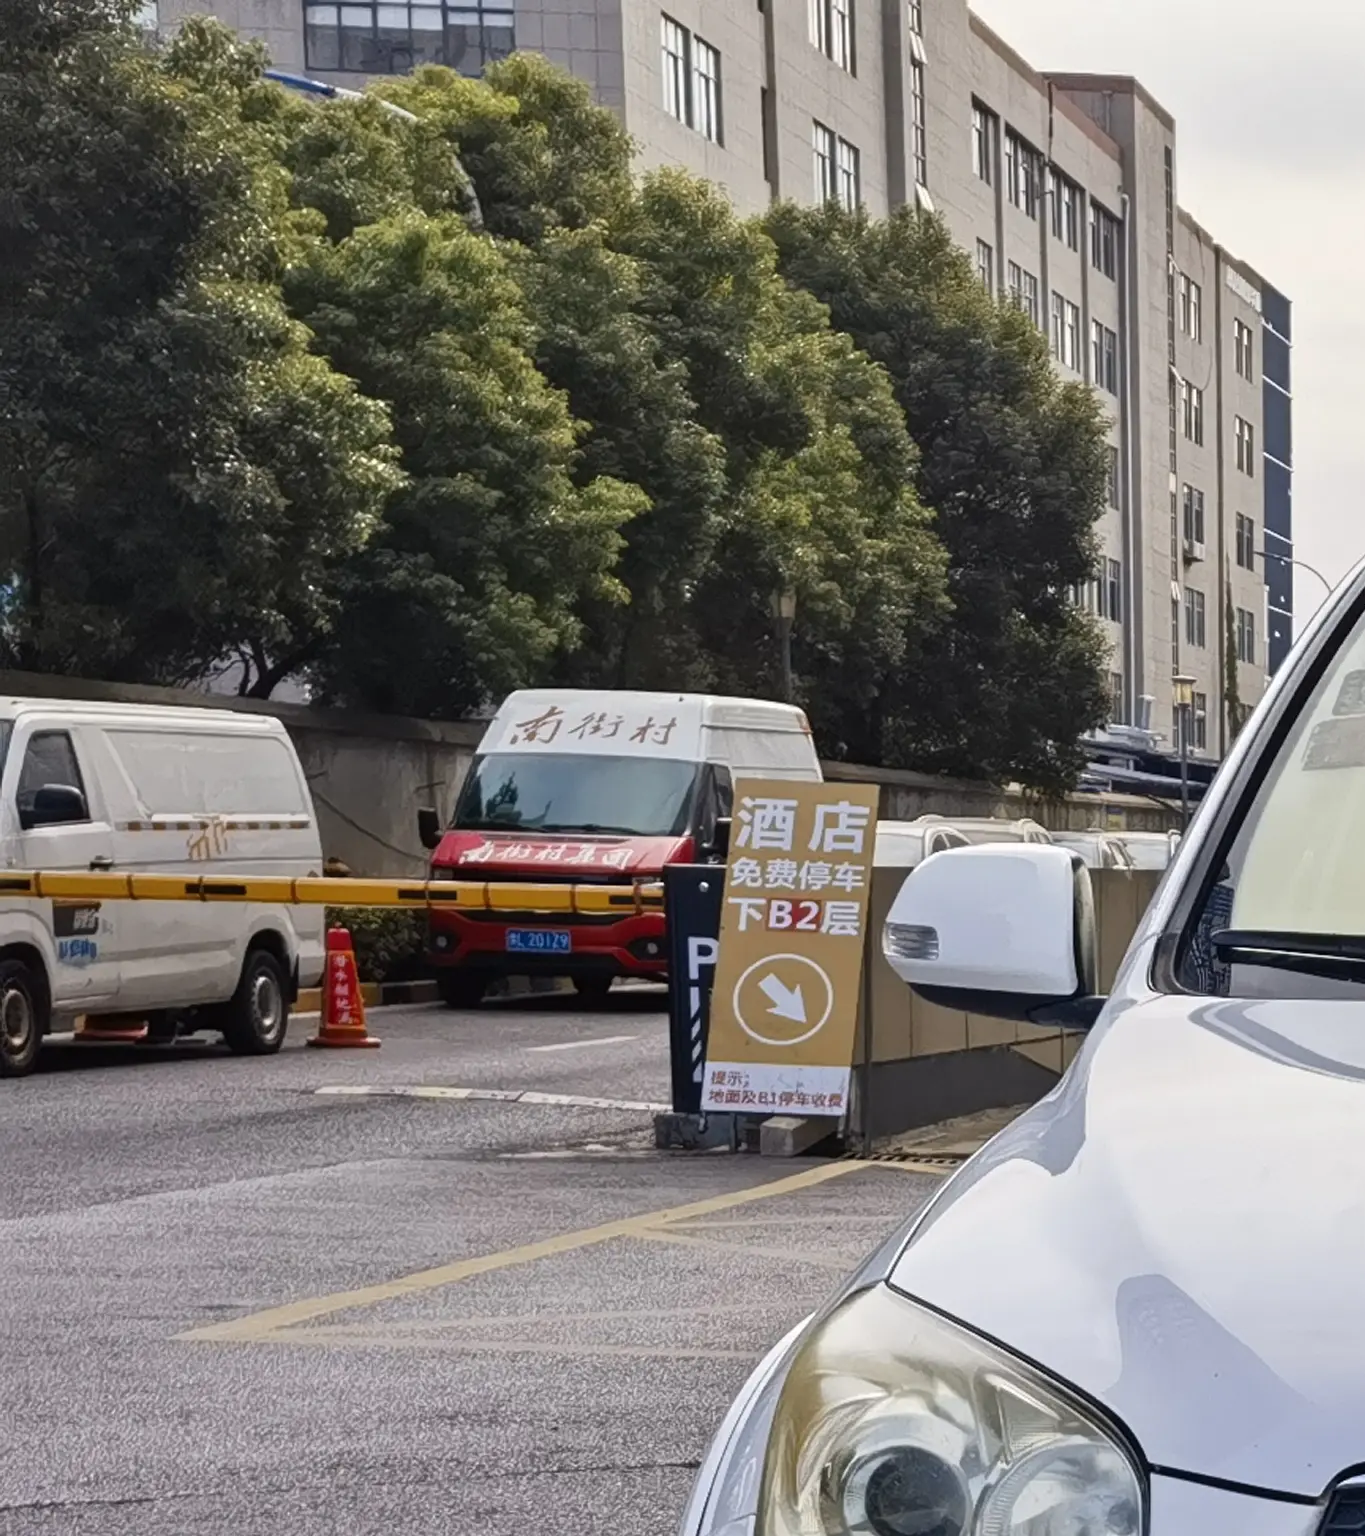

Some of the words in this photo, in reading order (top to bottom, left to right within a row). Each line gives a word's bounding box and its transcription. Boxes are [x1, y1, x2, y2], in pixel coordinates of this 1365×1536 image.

[509, 705, 678, 746] 南街村
[734, 796, 871, 854] 酒店
[458, 839, 635, 871] 南街村集团
[730, 858, 866, 893] 免费停车
[726, 896, 862, 937] 下B2层
[708, 1089, 844, 1109] 地面及B1停车收费
